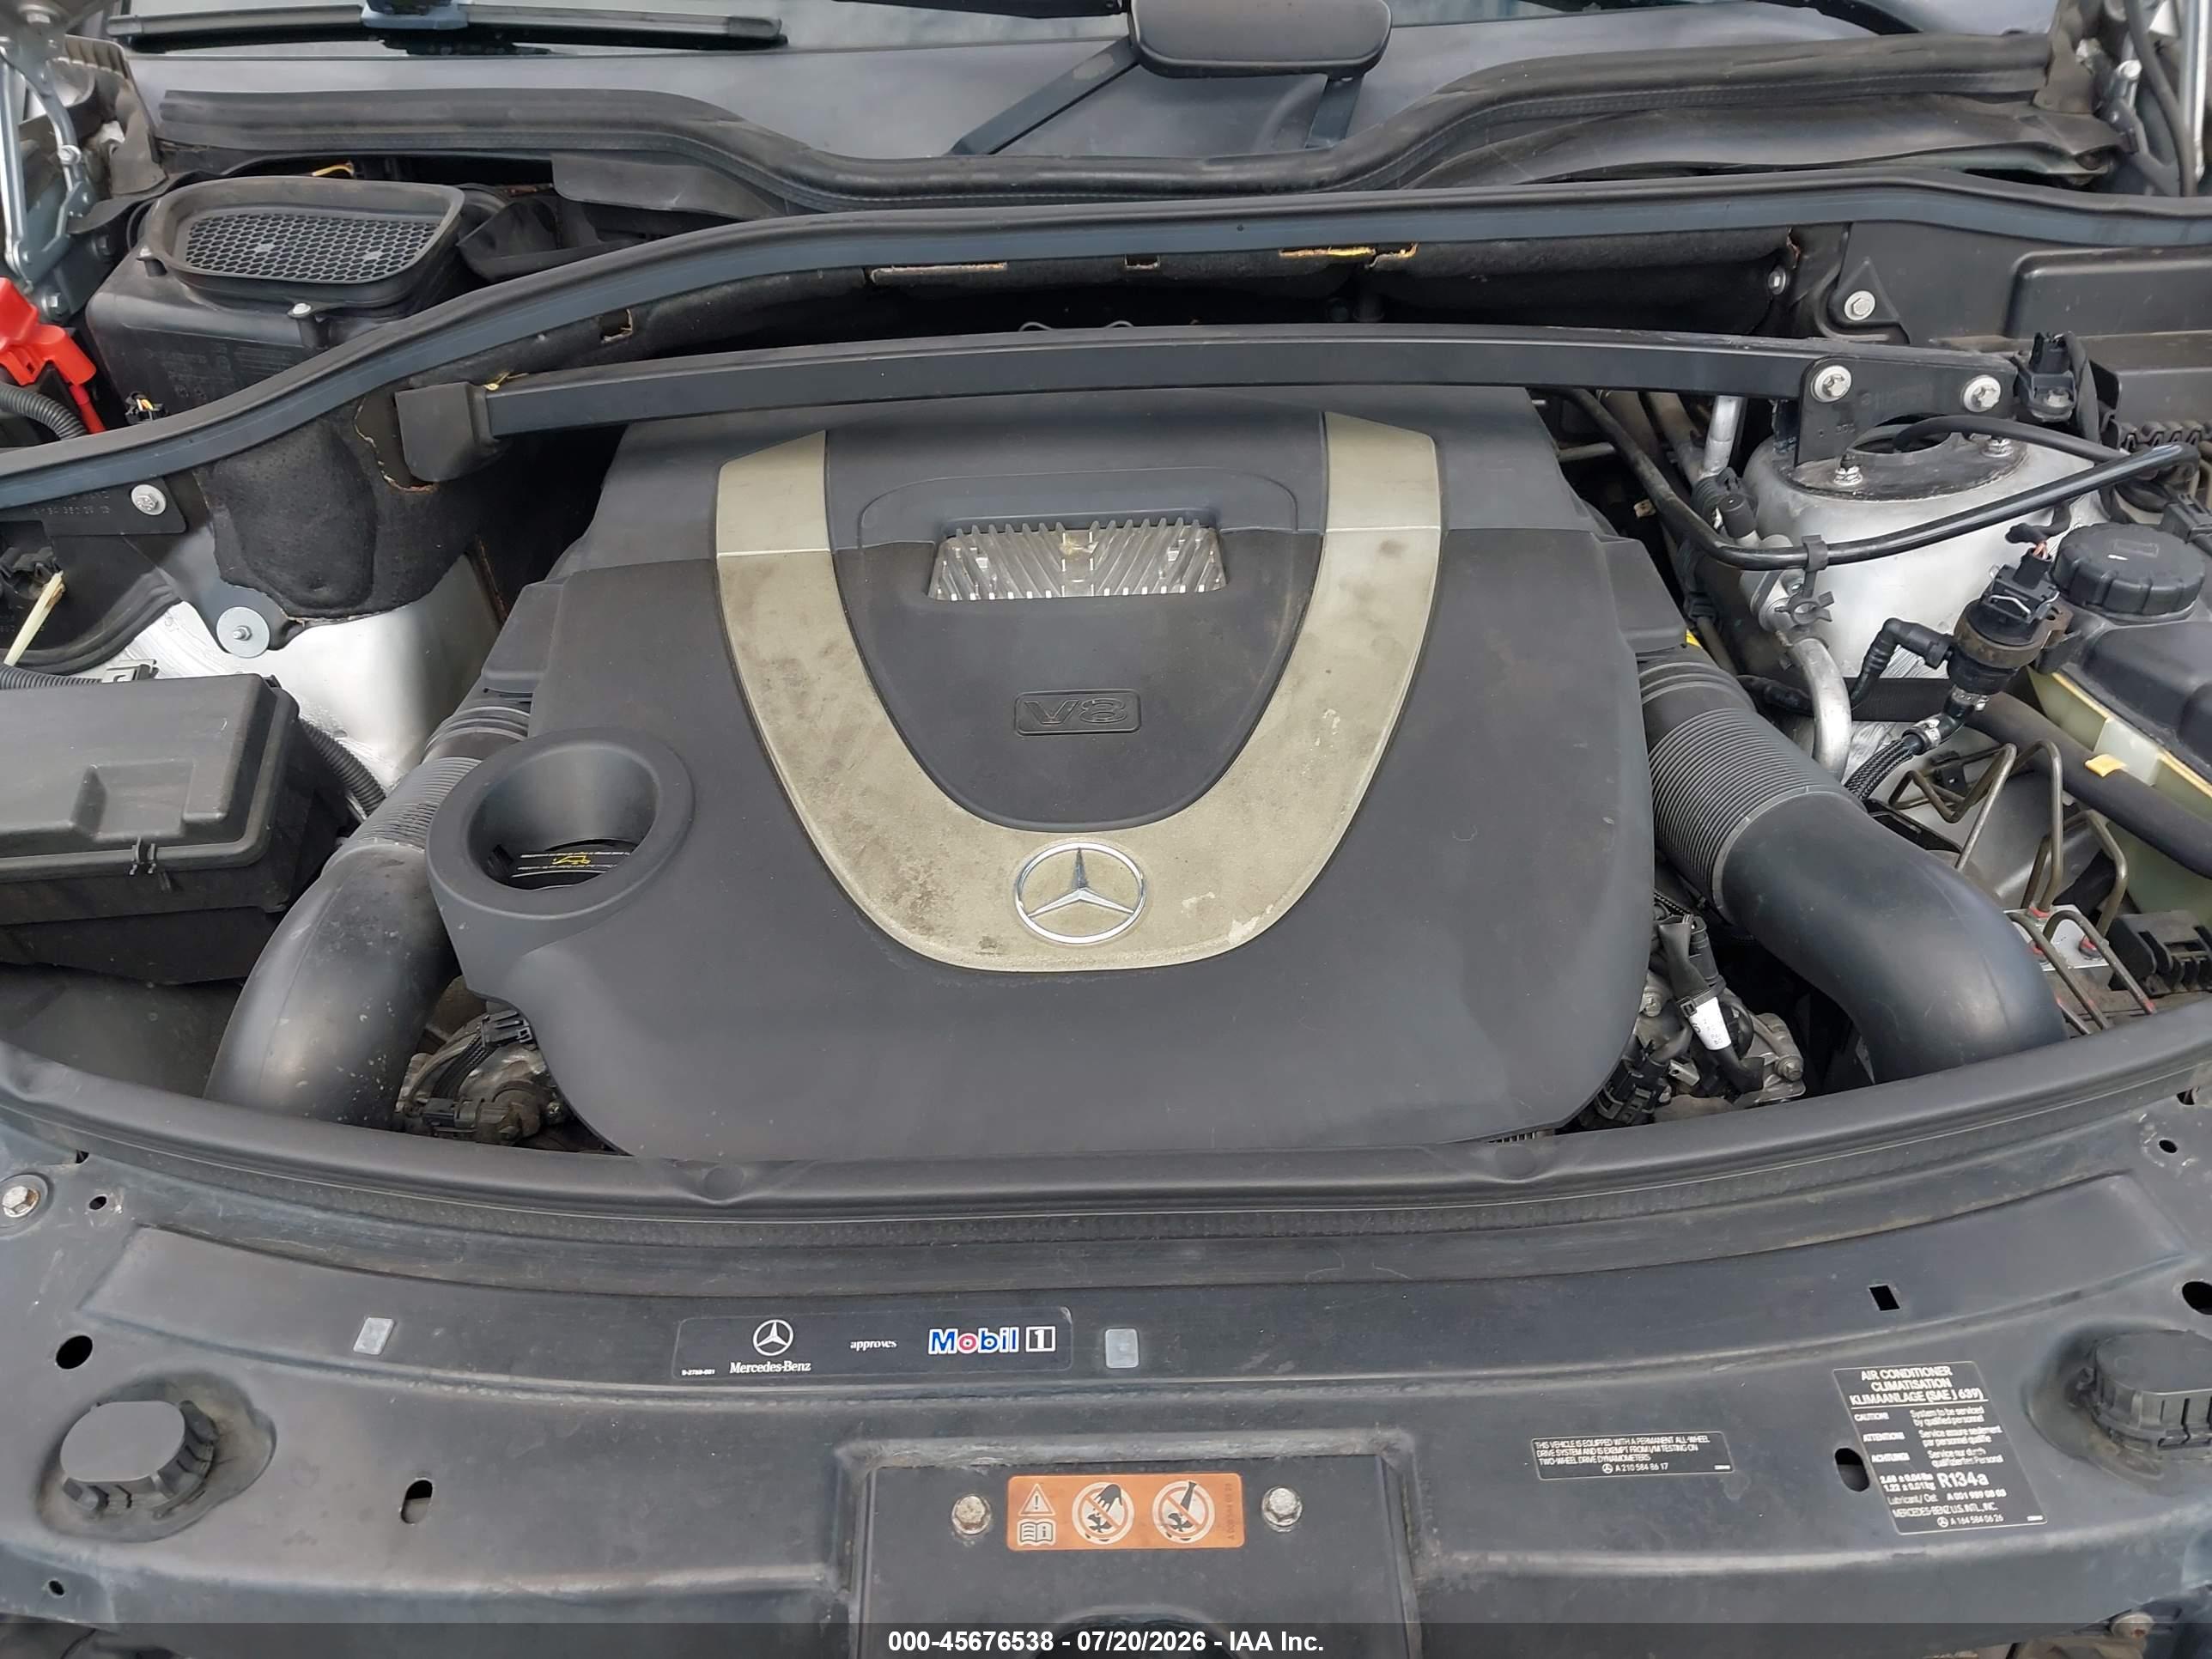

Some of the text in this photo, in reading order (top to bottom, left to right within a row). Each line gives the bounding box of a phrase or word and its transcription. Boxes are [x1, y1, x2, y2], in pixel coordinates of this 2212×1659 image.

[850, 1339, 897, 1352] approves
[928, 1327, 1019, 1354] Mobil
[730, 1361, 811, 1374] Mercedes-Benz
[1861, 1366, 1954, 1381] AIR CONDITIONER
[1871, 1377, 1953, 1392] CLIMATISATION
[1849, 1390, 1926, 1405] KLIMAANLAGE
[1926, 1389, 1951, 1403] (SAE
[1958, 1388, 1984, 1401] 639)
[1549, 1440, 1576, 1449] VEHICLE
[1583, 1438, 1613, 1447] EQUIPPED
[1637, 1436, 1674, 1444] PERMANENT
[1556, 1448, 1582, 1456] SYSTEM
[1936, 1471, 1989, 1488] R134a
